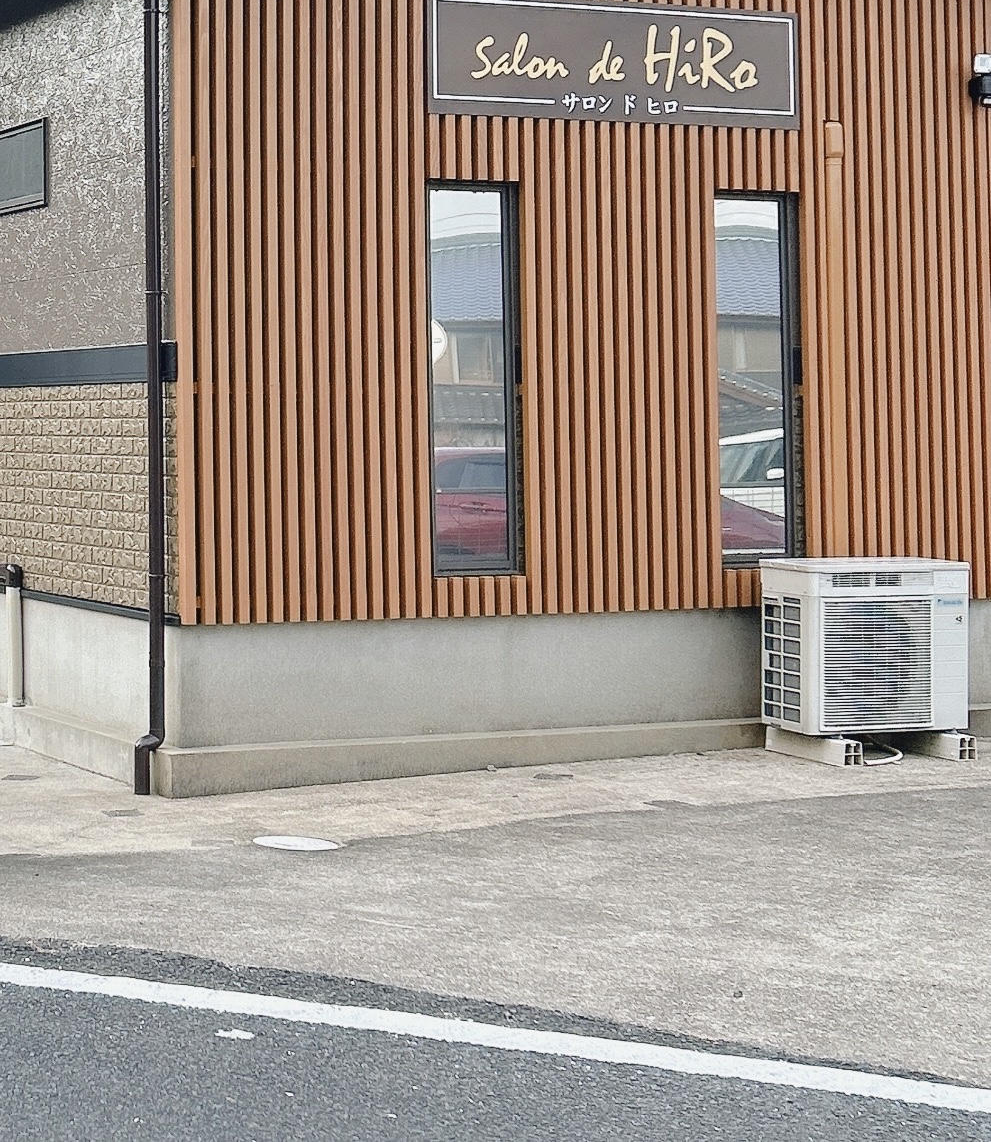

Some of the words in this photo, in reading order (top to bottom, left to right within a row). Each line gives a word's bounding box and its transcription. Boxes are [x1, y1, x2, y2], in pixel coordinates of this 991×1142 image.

[471, 32, 570, 80] Salon
[588, 40, 626, 85] de
[643, 24, 759, 93] HiRo
[561, 92, 613, 113] サロン
[623, 93, 637, 116] ド
[646, 97, 679, 115] ヒロ
